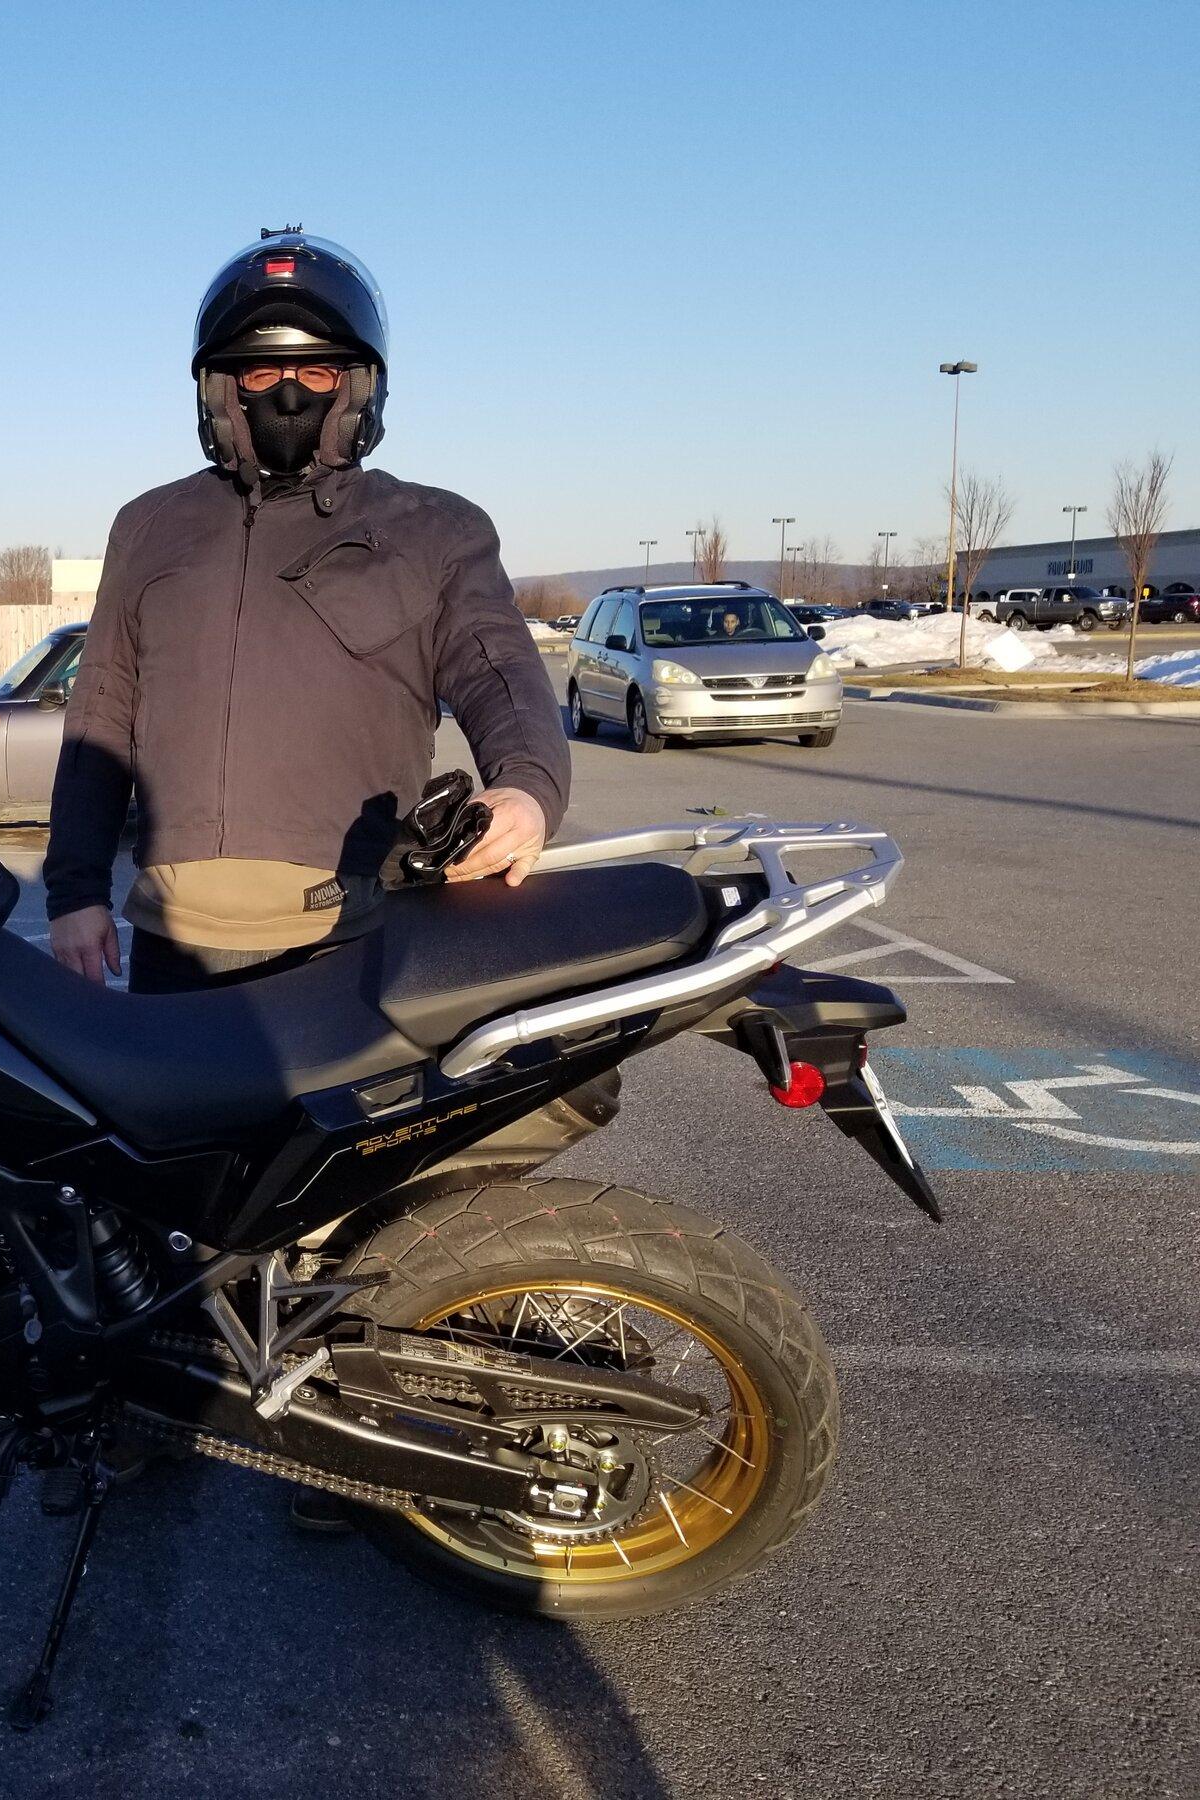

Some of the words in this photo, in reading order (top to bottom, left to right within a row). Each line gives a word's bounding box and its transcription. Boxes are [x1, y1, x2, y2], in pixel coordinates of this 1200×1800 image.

[309, 881, 342, 904] INDIAN
[309, 892, 345, 910] MOTORCYCLE
[355, 1103, 478, 1150] ADVENTURE
[362, 1125, 437, 1156] SPORTS
